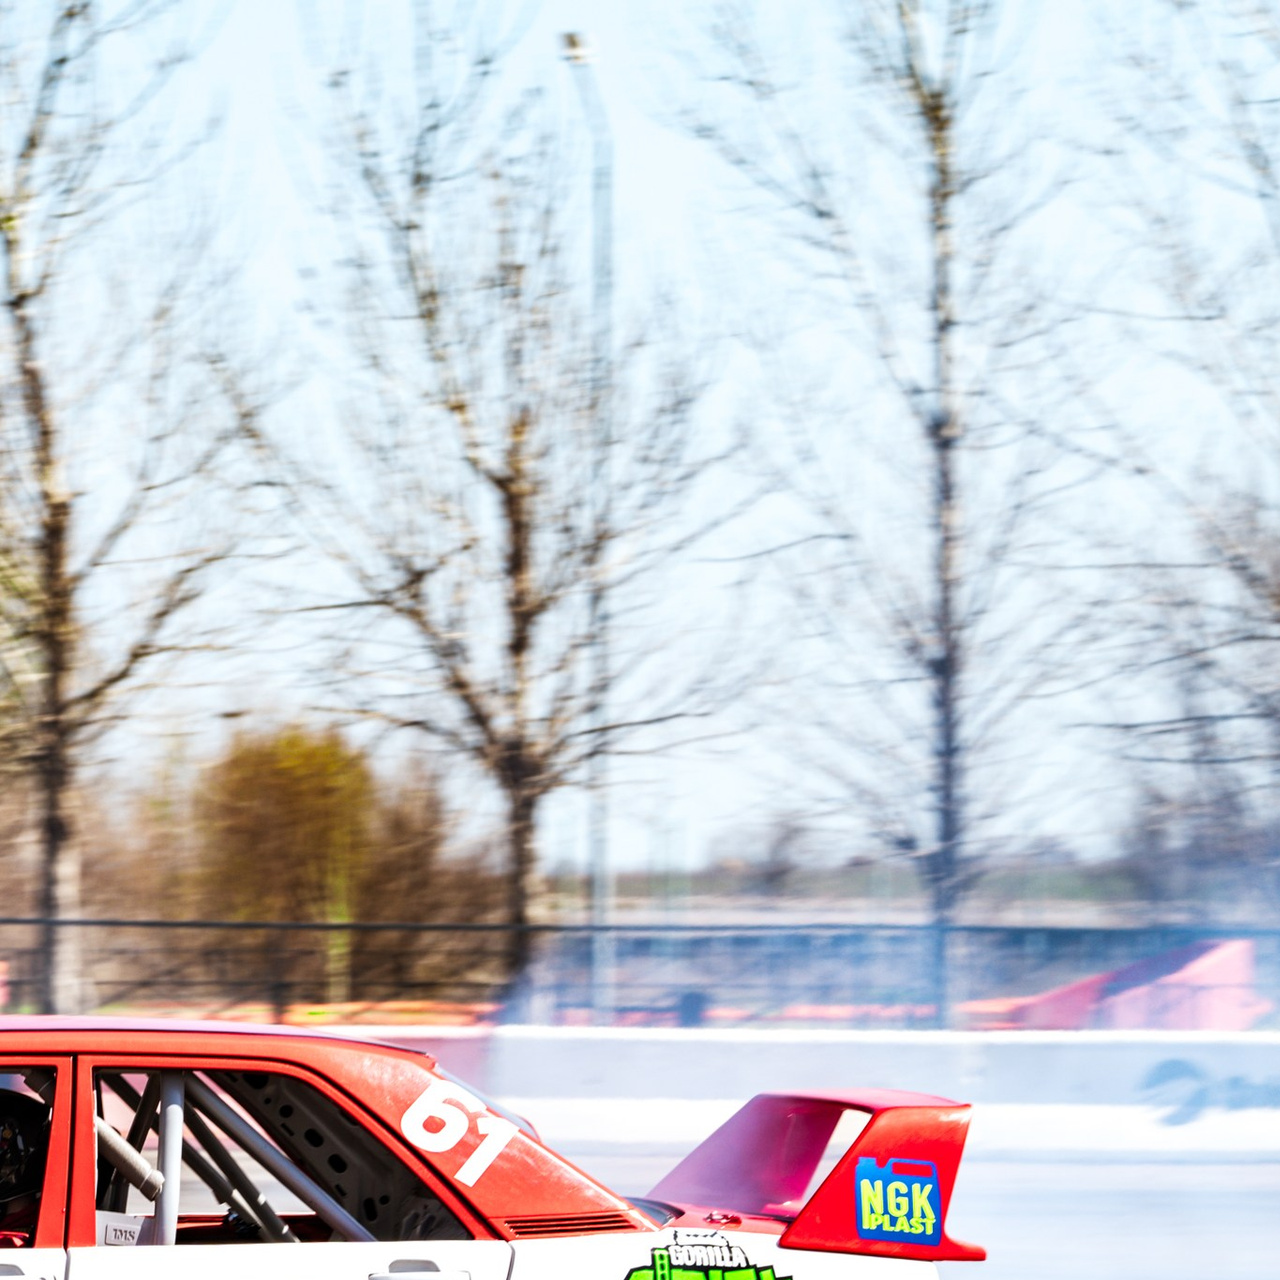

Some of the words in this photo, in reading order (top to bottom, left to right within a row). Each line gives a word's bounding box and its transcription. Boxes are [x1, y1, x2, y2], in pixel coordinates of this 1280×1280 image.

[401, 1079, 520, 1187] 61
[860, 1179, 935, 1229] NGK
[869, 1213, 936, 1235] PLAST
[670, 1245, 748, 1268] GORILLA
